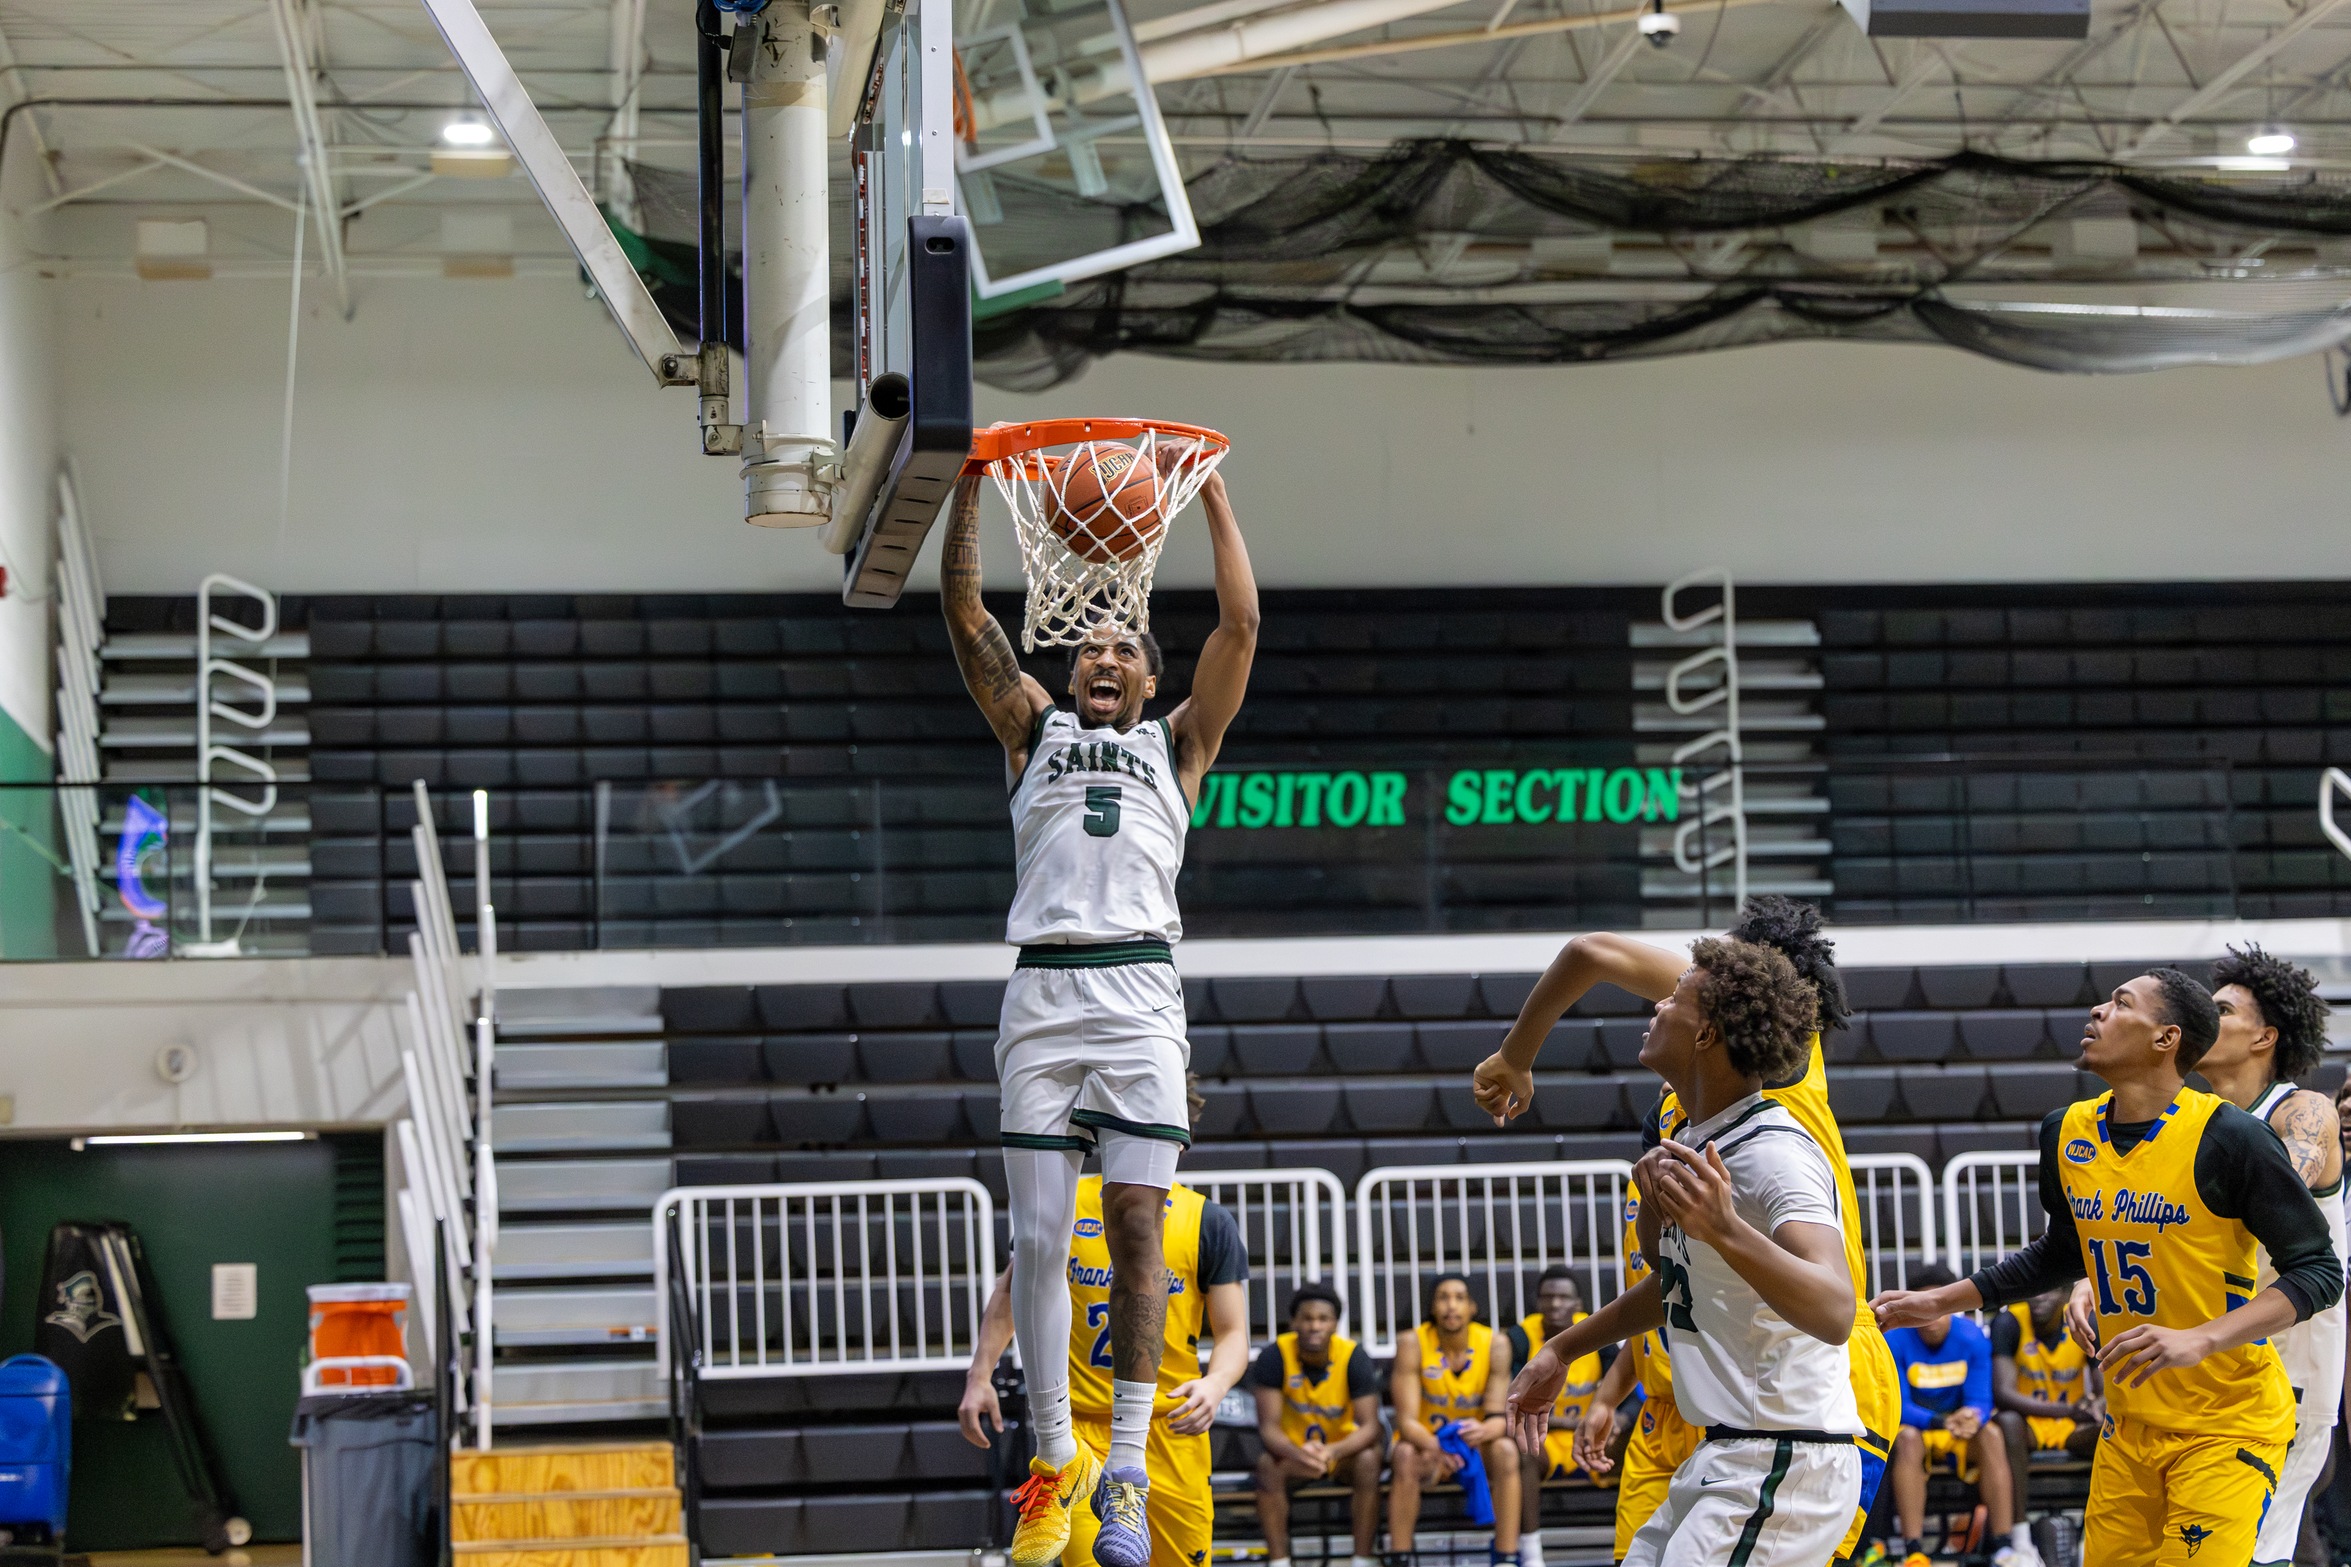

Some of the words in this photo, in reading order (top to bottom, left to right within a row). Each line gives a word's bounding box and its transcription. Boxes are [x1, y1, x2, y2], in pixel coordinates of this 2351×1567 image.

[1047, 741, 1158, 790] SAINTS
[1082, 786, 1122, 838] 5
[1190, 771, 1408, 829] VISITOR
[1445, 767, 1683, 825] SECTION
[2067, 1142, 2095, 1160] WJCAC
[2111, 1188, 2191, 1234] Phillips
[2088, 1238, 2158, 1316] 15
